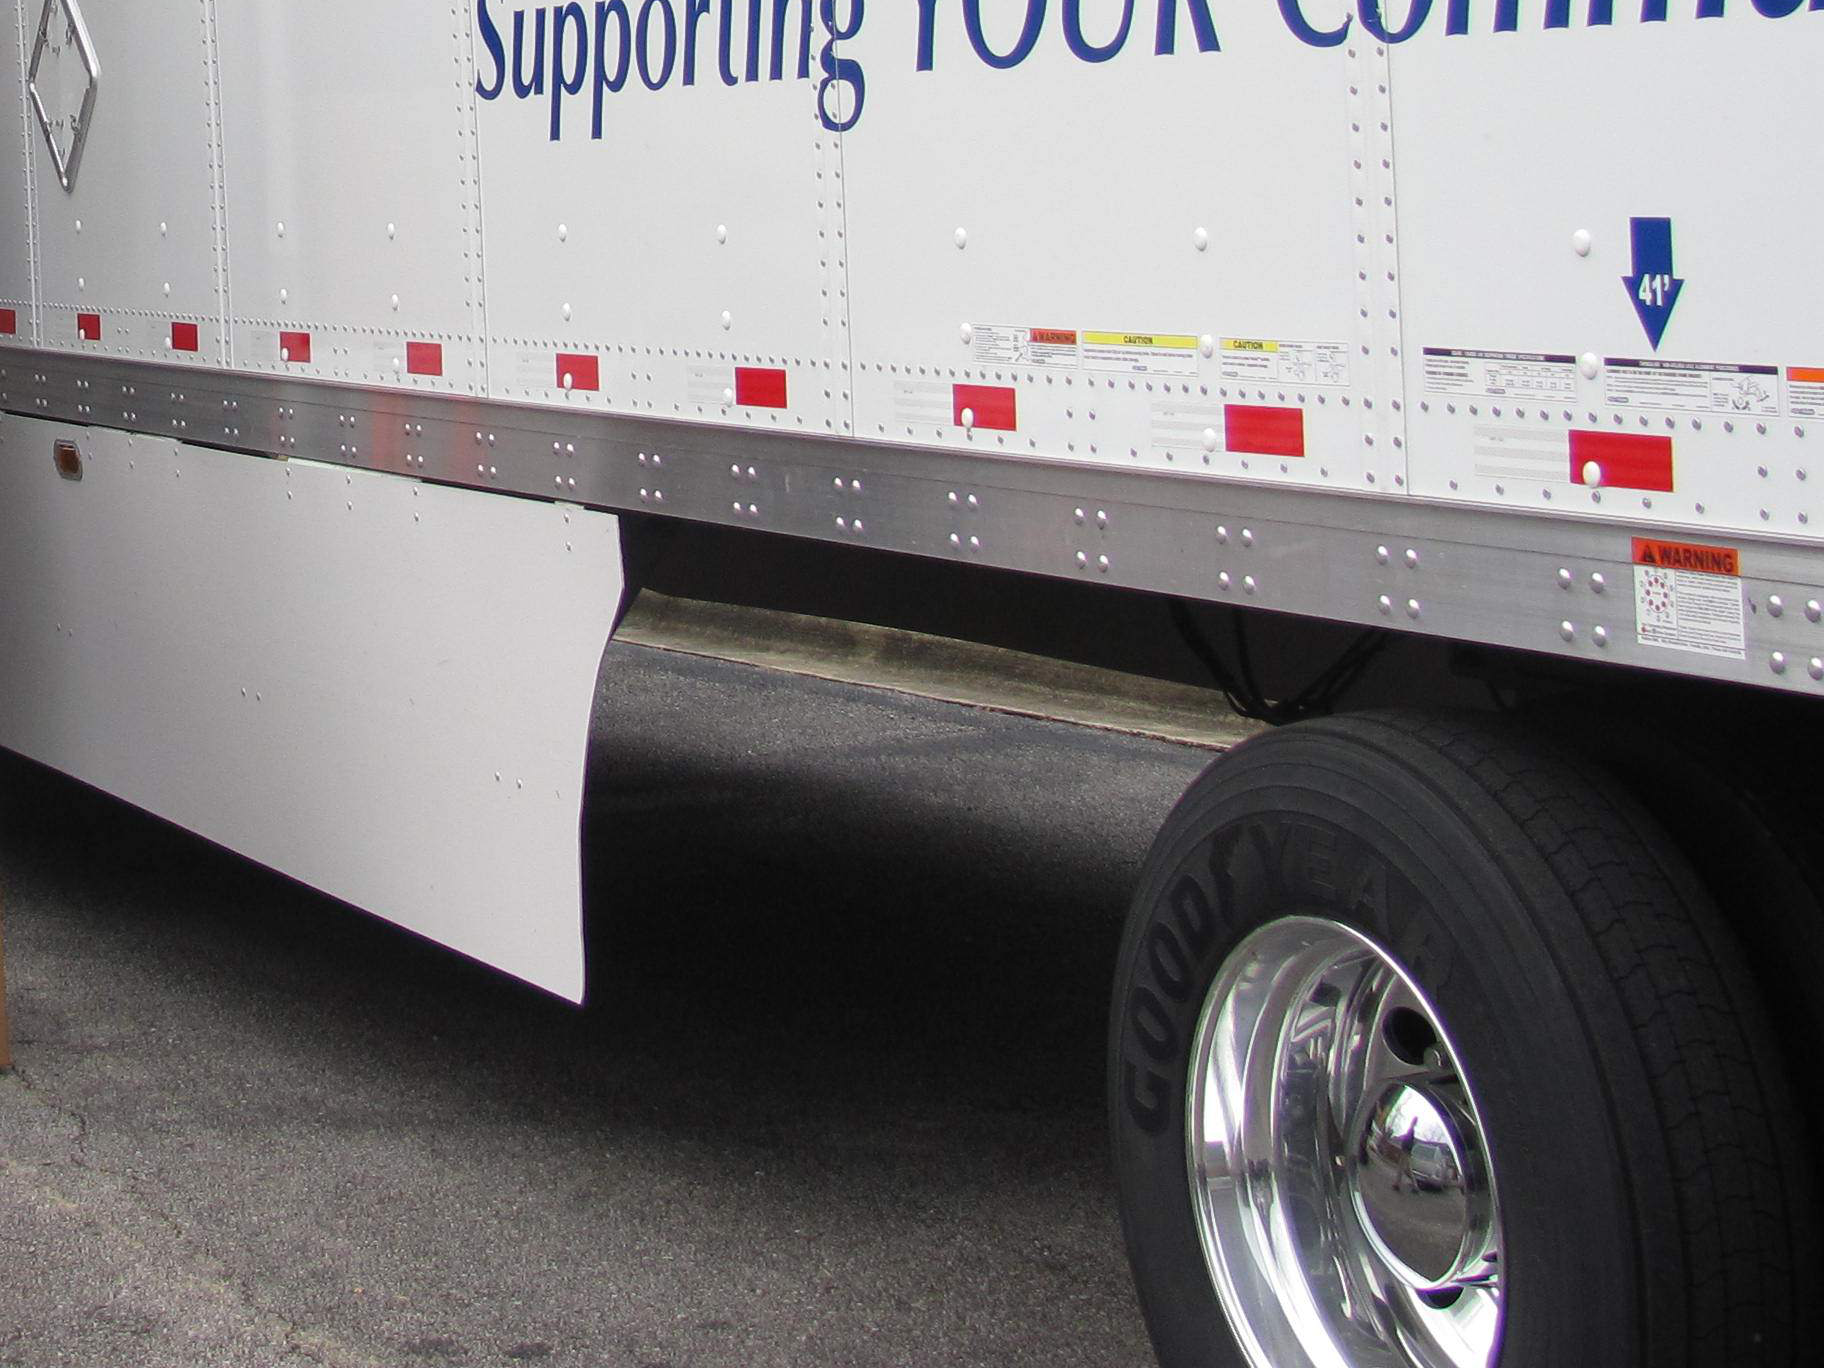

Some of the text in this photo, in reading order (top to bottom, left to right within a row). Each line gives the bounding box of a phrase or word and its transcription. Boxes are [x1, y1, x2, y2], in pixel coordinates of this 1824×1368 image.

[1123, 335, 1154, 346] CAUTION
[1232, 340, 1264, 351] CAUTION
[1658, 545, 1734, 574] WARNING
